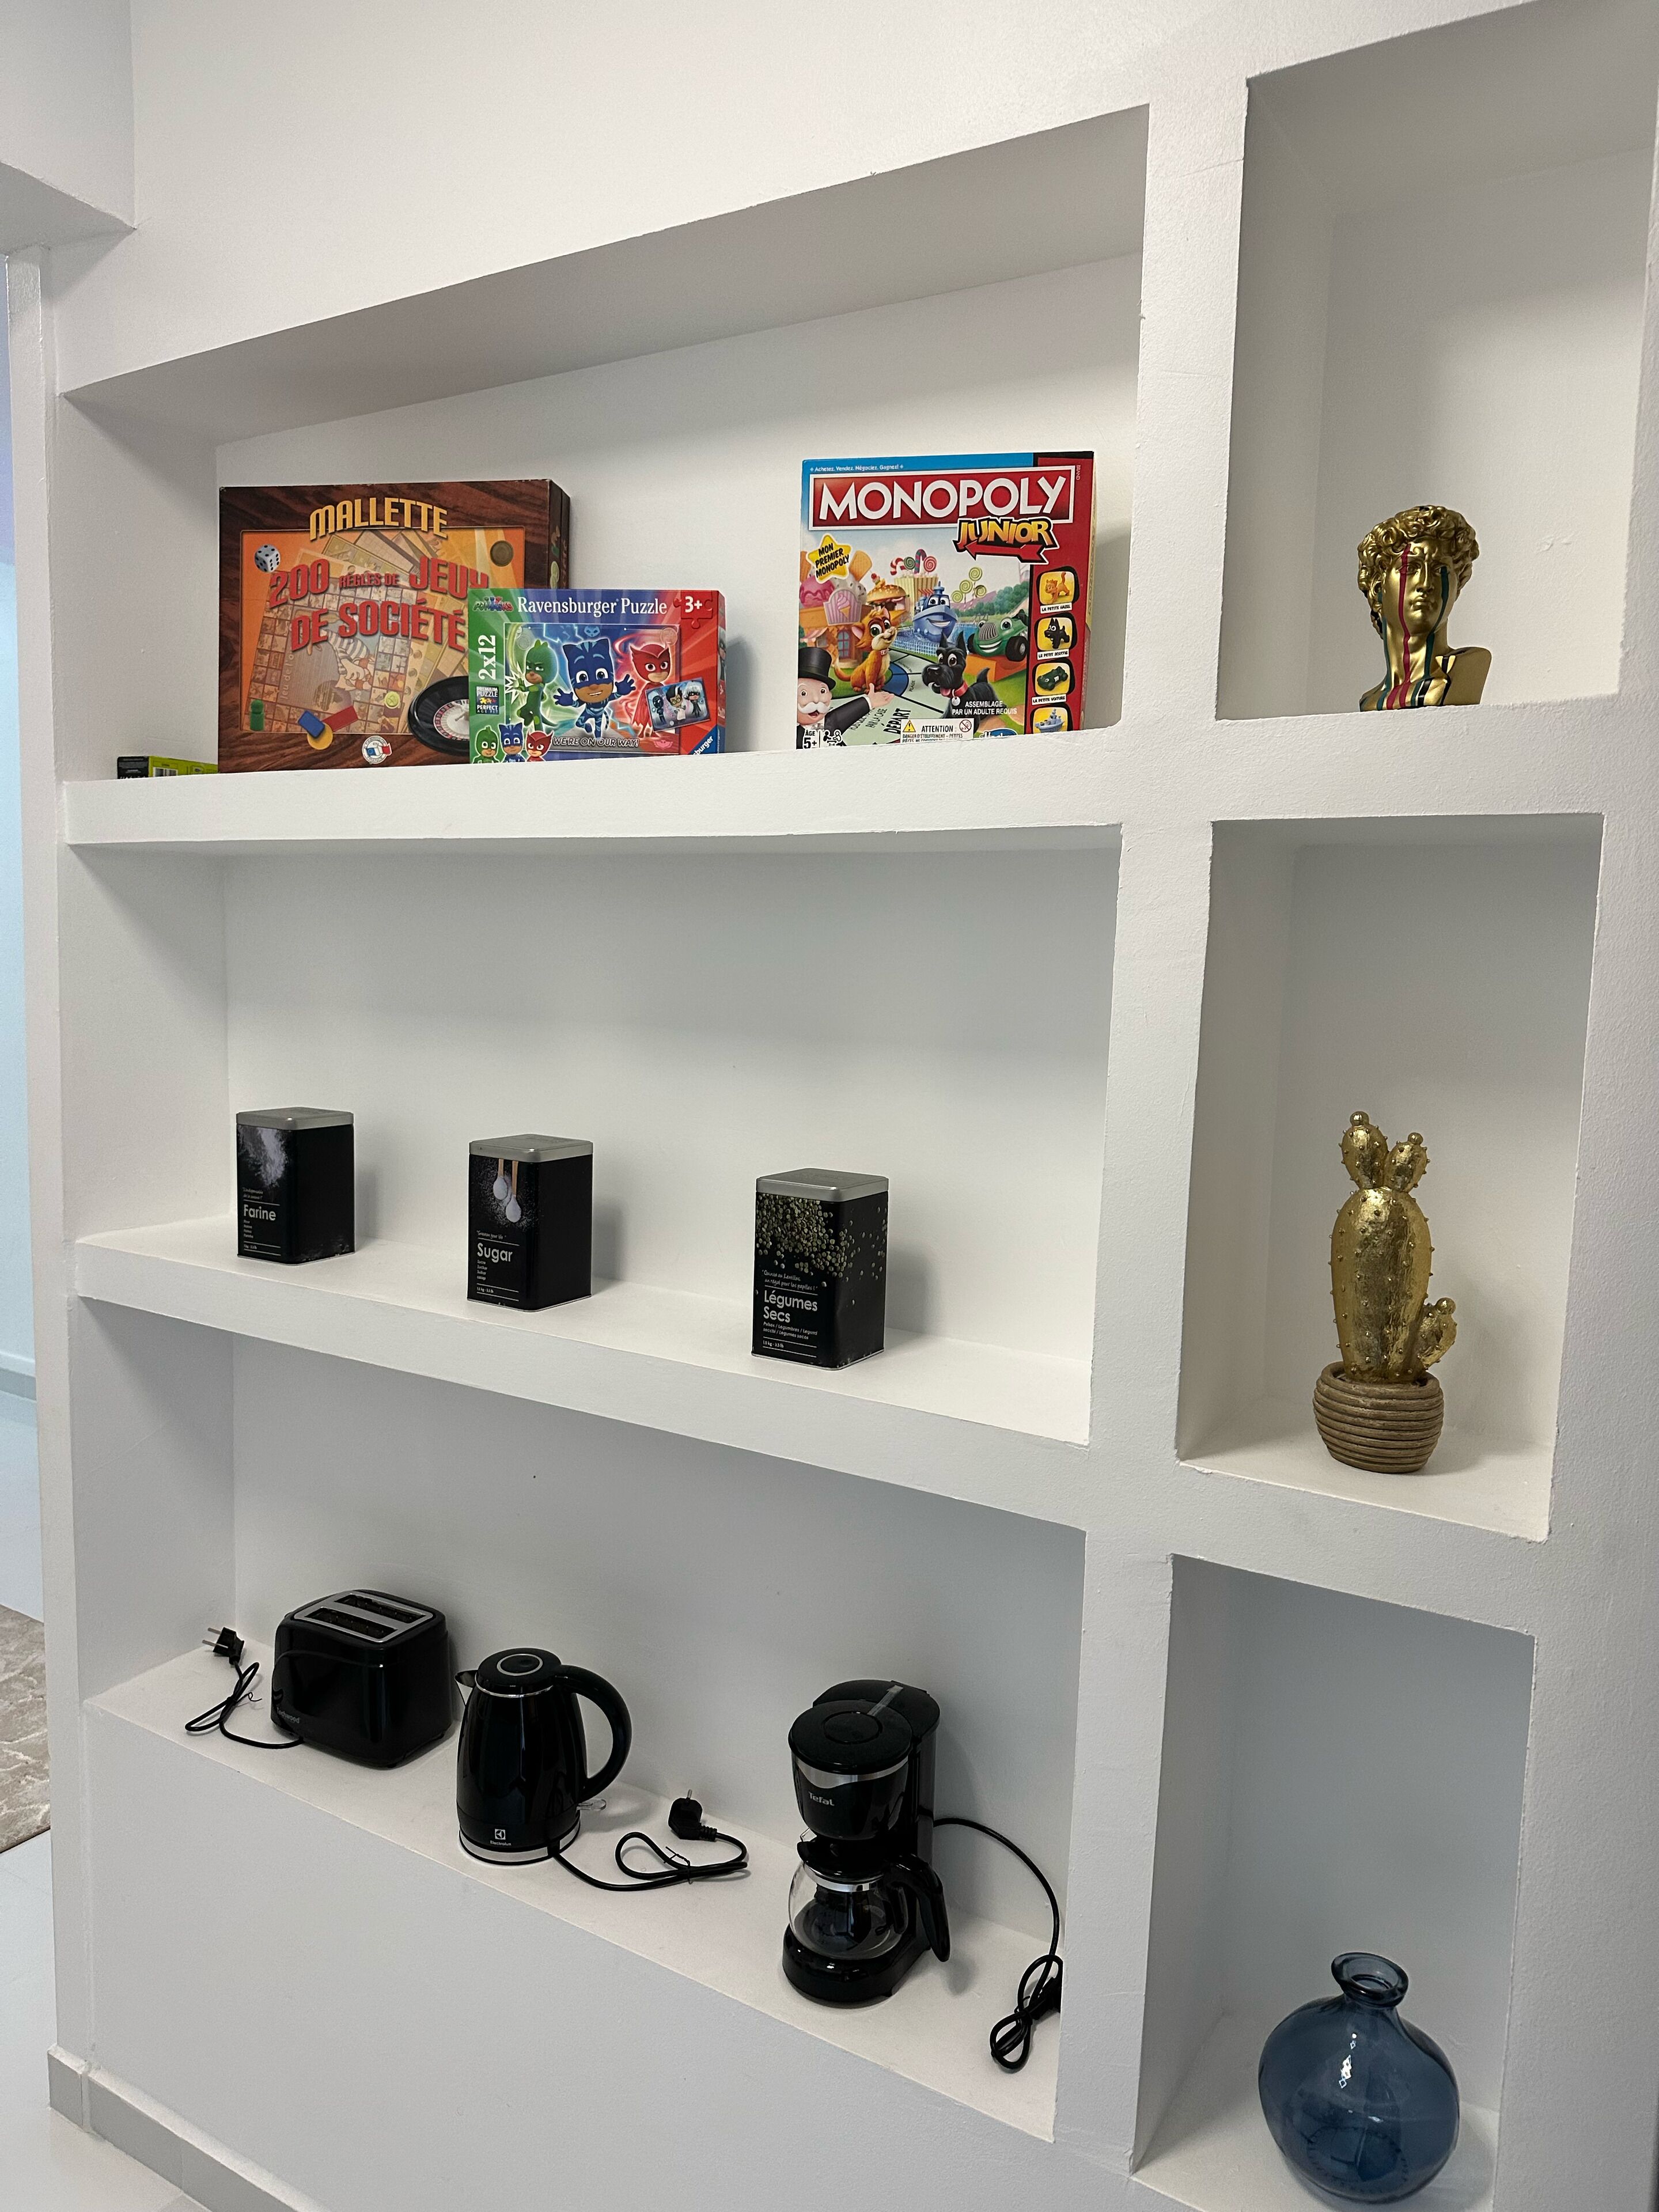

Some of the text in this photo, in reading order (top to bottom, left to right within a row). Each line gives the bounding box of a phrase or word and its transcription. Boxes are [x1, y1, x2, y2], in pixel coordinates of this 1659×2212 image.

[819, 475, 1066, 521] MONOPOLY
[309, 497, 448, 540] MALLETTE
[956, 520, 1054, 550] JUNIOR
[815, 548, 843, 568] PREMIER
[819, 543, 834, 556] MON
[816, 554, 849, 578] MONOPOLY
[269, 558, 329, 608] 200
[384, 573, 400, 586] DE
[517, 596, 667, 618] Ravensburger Puzzle
[685, 596, 703, 613] 3+
[291, 597, 465, 653] DE SOCIÉTÉ
[478, 634, 497, 680] 2x12
[553, 737, 639, 747] WE'RE ON OUR WAY!
[804, 737, 817, 749] 5+
[244, 1203, 276, 1221] Farine
[477, 1243, 513, 1263] Sugar
[764, 1290, 818, 1312] Légumes
[763, 1306, 790, 1323] Secs
[808, 1790, 835, 1806] Tefal
